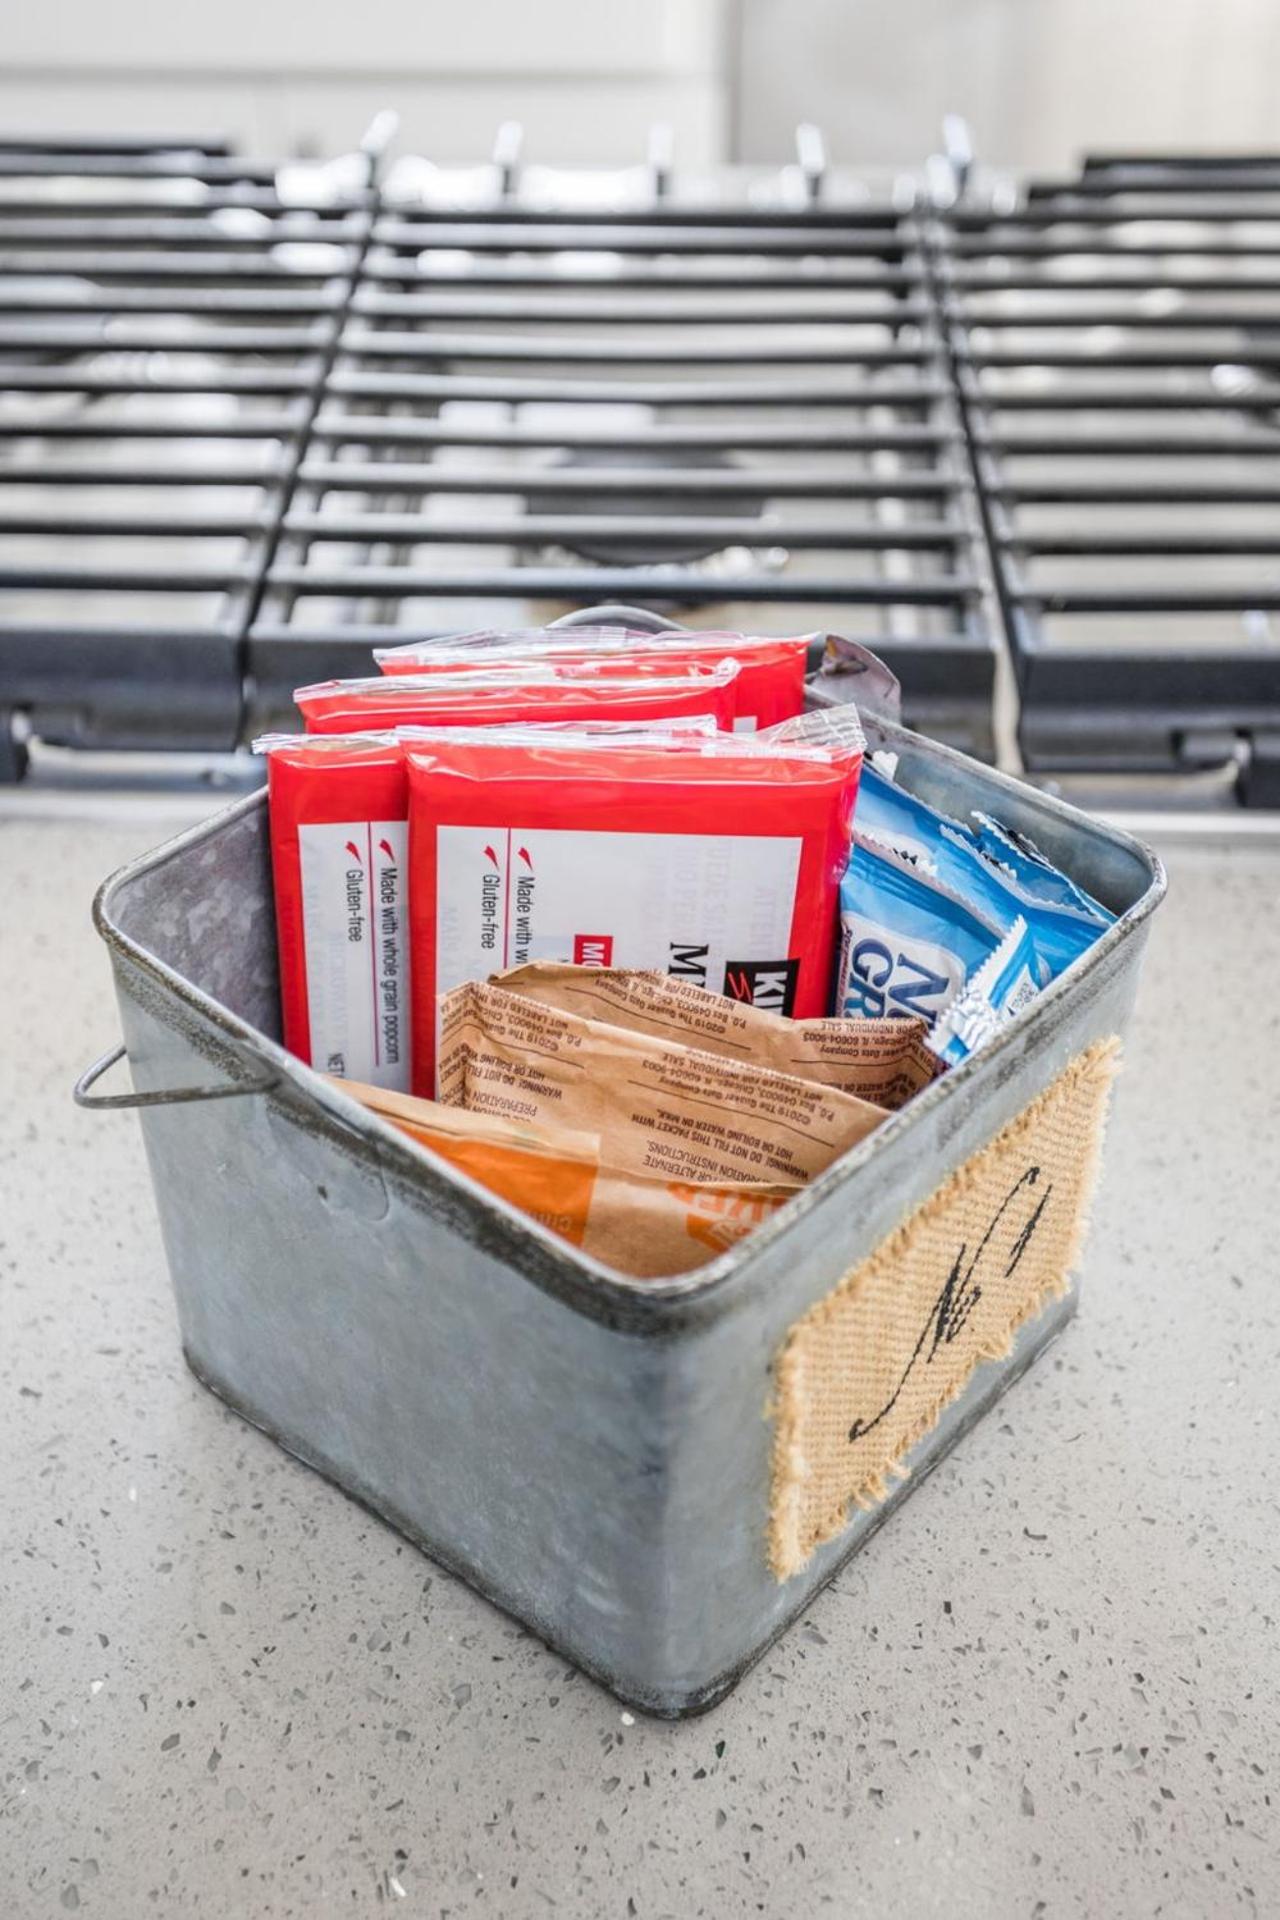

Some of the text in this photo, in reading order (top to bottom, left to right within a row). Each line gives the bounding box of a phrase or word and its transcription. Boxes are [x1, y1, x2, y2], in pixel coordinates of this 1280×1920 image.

[346, 869, 365, 943] Gluten-free
[482, 873, 501, 950] Gluten-free
[516, 876, 535, 914] Made
[516, 917, 534, 947] with
[380, 867, 400, 1065] Made with whole grain popcorn
[668, 942, 709, 987] M
[845, 939, 893, 1018] GR
[754, 970, 787, 1016] KI
[642, 1154, 697, 1179] ALTERNATE
